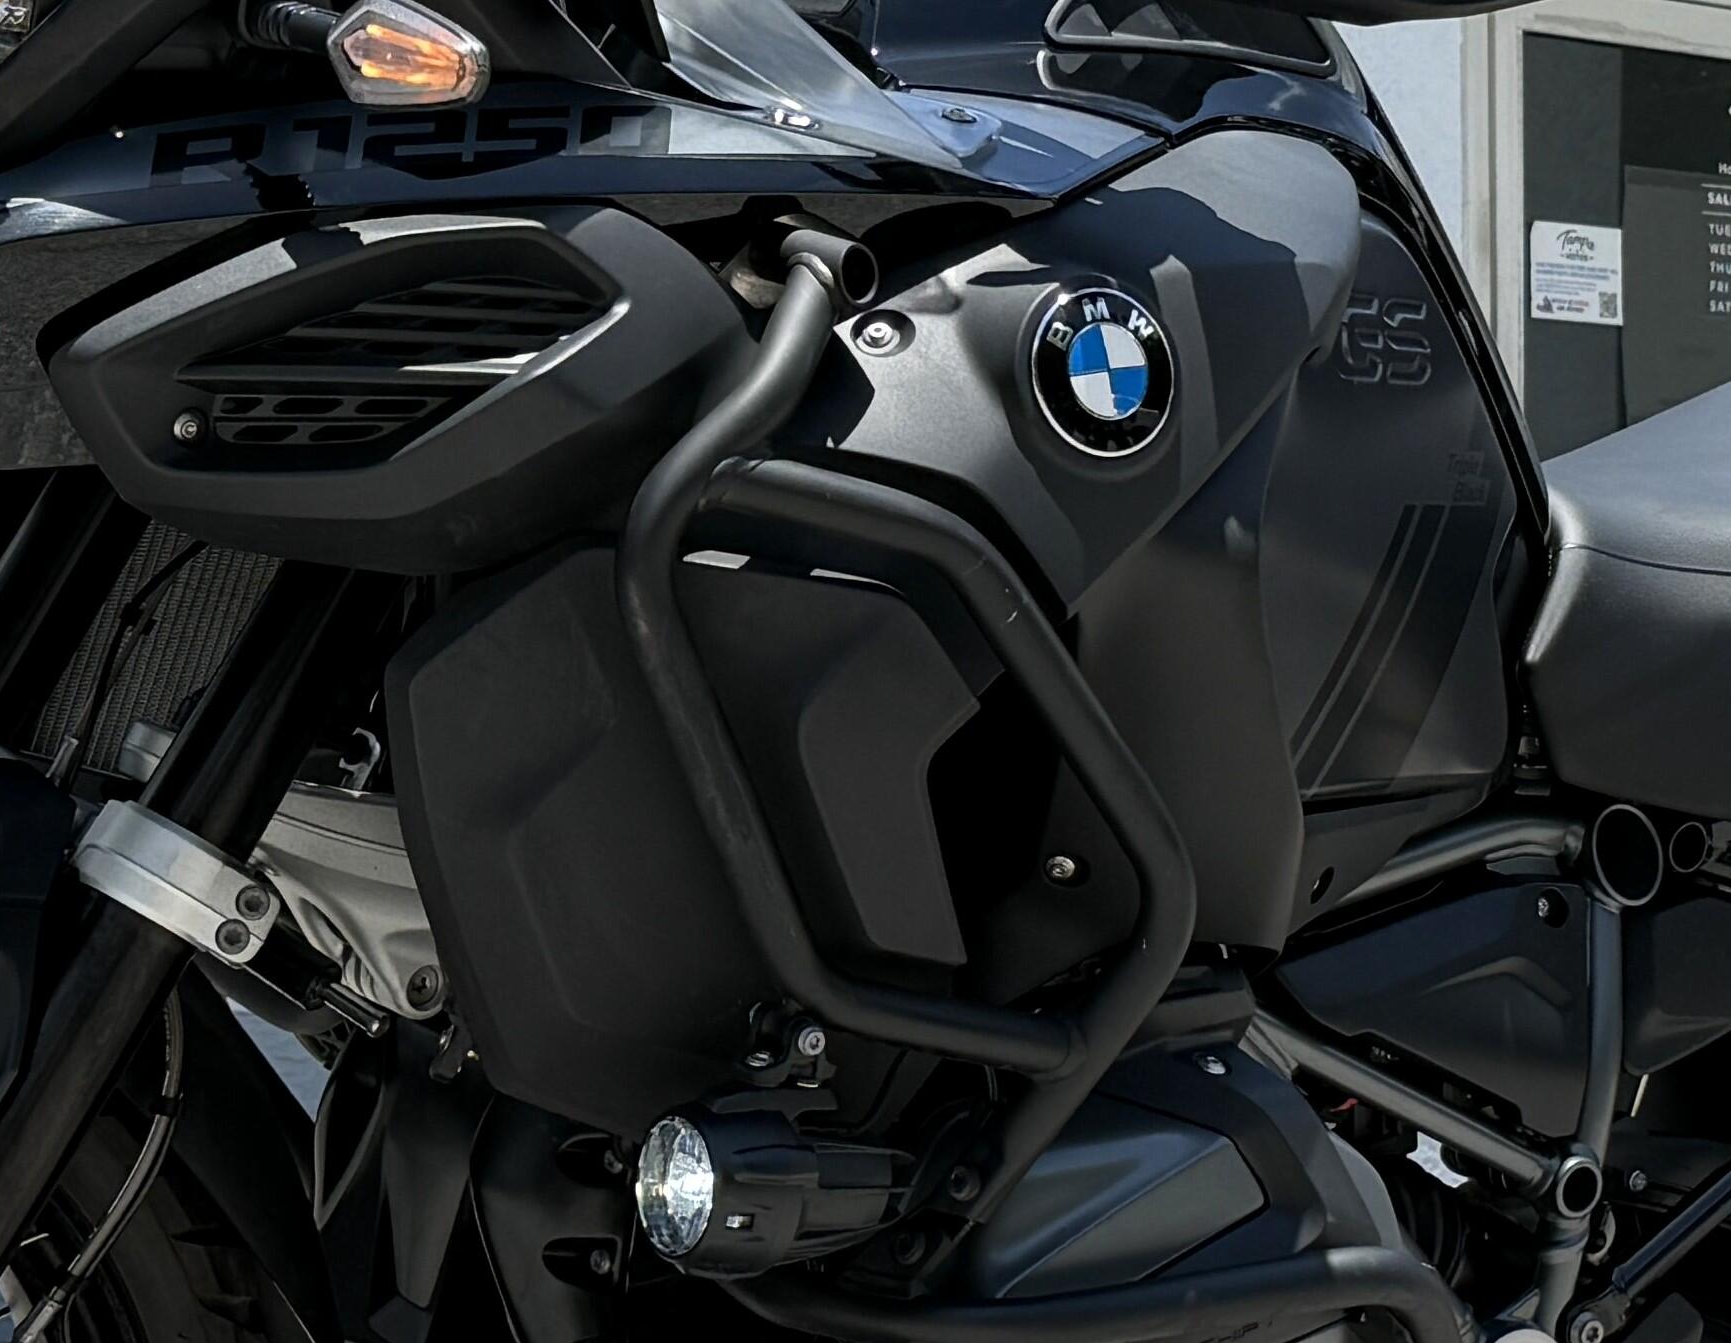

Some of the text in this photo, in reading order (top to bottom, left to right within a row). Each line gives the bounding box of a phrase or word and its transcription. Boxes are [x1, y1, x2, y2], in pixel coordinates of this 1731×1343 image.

[1709, 224, 1731, 237] TUE
[1709, 280, 1729, 293] FRI
[1709, 300, 1731, 313] SAT
[1046, 296, 1156, 351] BMW
